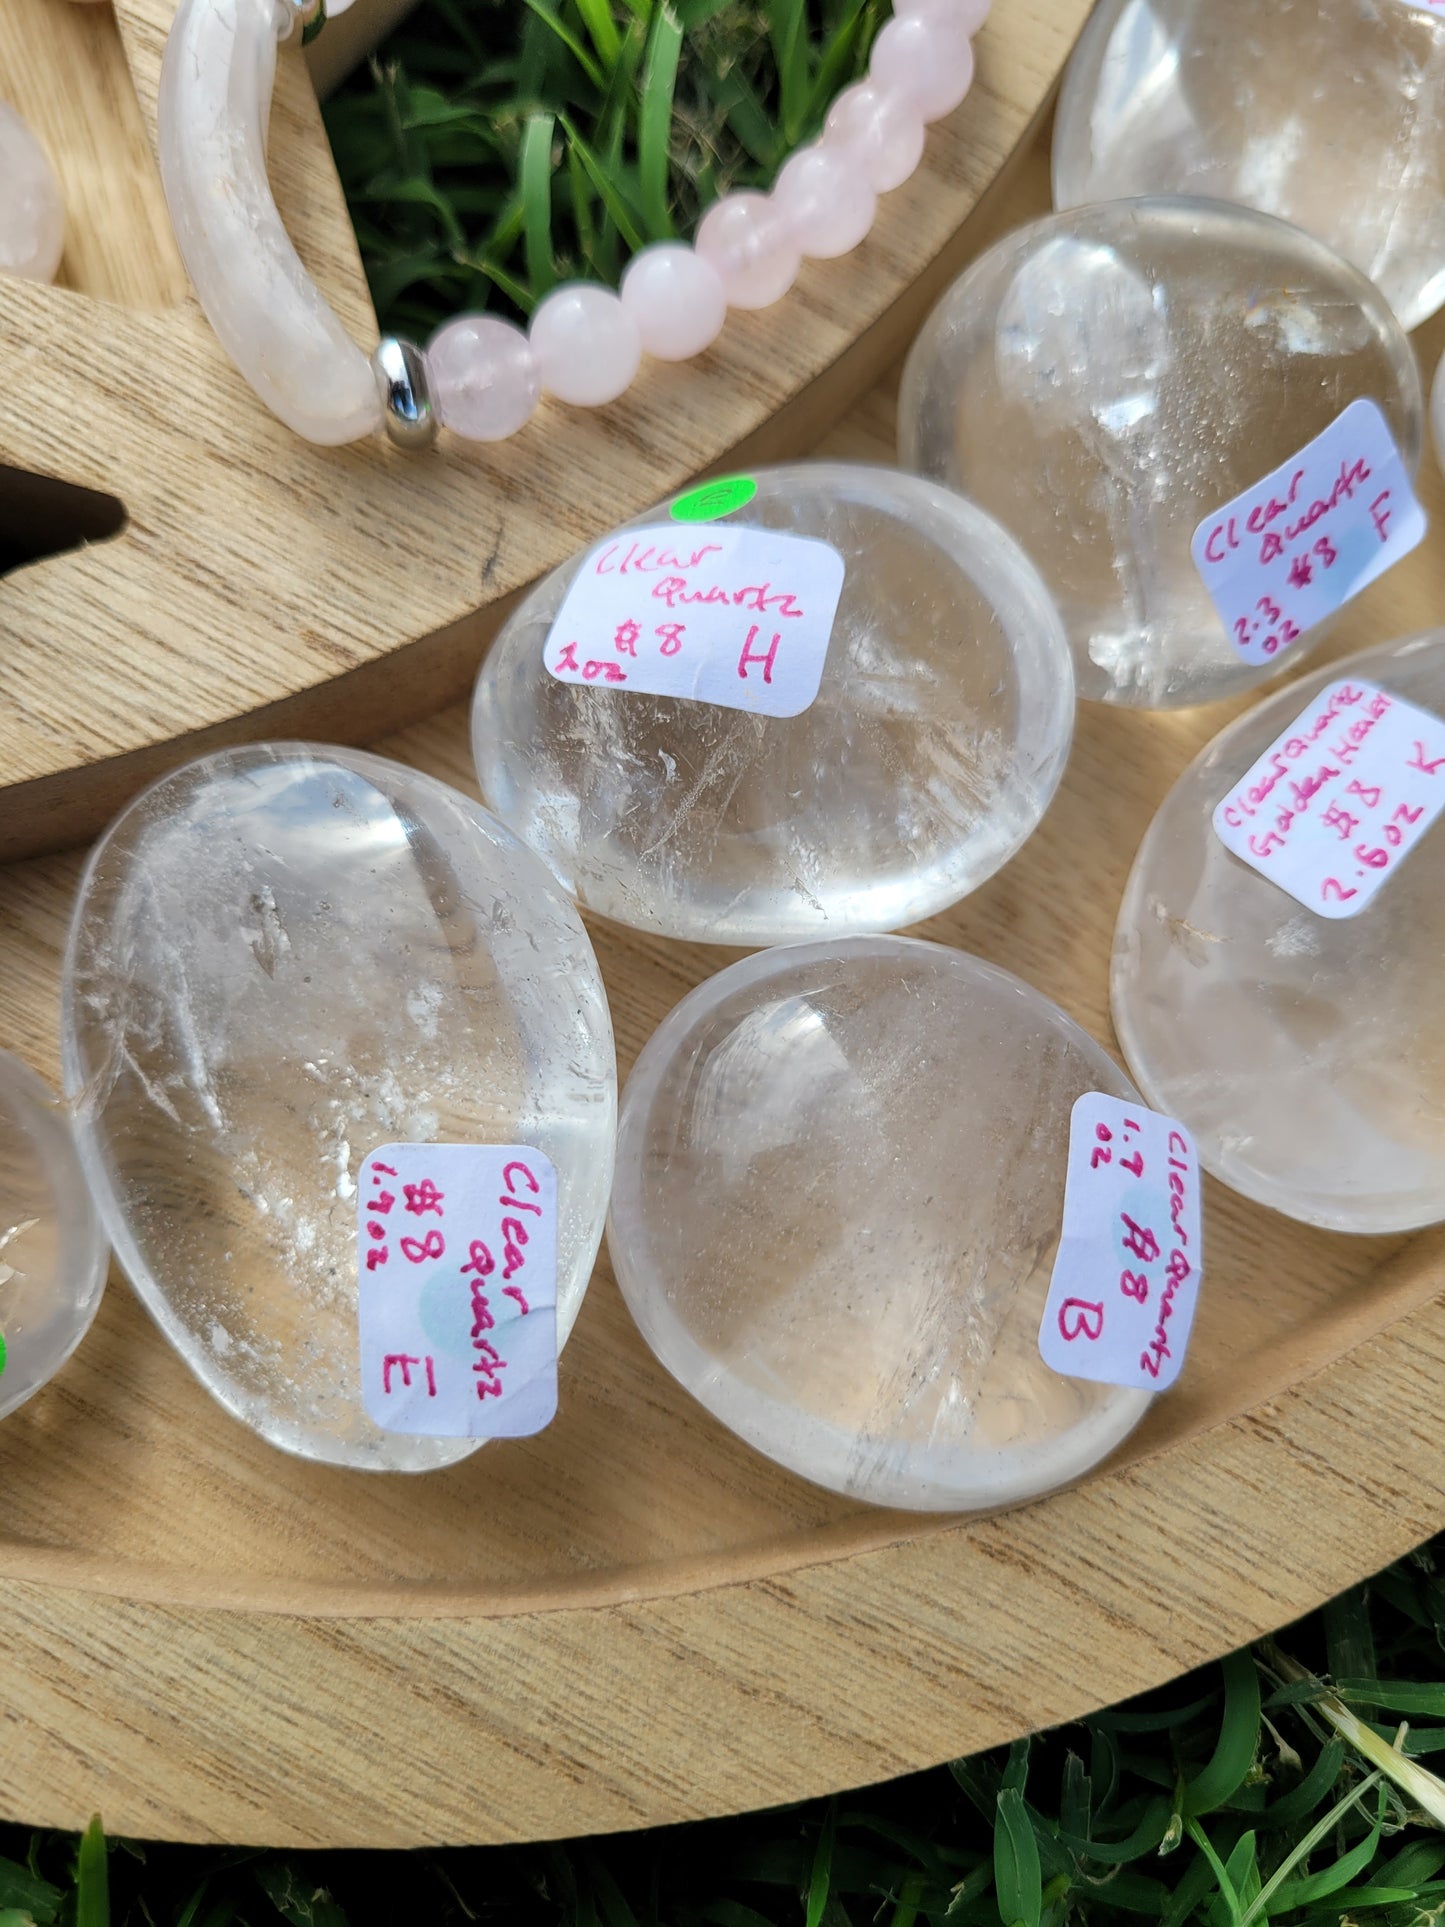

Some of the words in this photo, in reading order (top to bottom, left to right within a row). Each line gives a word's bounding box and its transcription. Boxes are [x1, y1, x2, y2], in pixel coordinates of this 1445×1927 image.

[1204, 469, 1304, 563] Clear
[1369, 490, 1392, 543] F
[595, 543, 723, 574] Clear
[1234, 596, 1281, 645] 2.3
[737, 624, 782, 684] H
[1405, 740, 1445, 775] K
[499, 1161, 543, 1316] Clear
[1057, 1296, 1104, 1341] B
[383, 1353, 437, 1397] E
